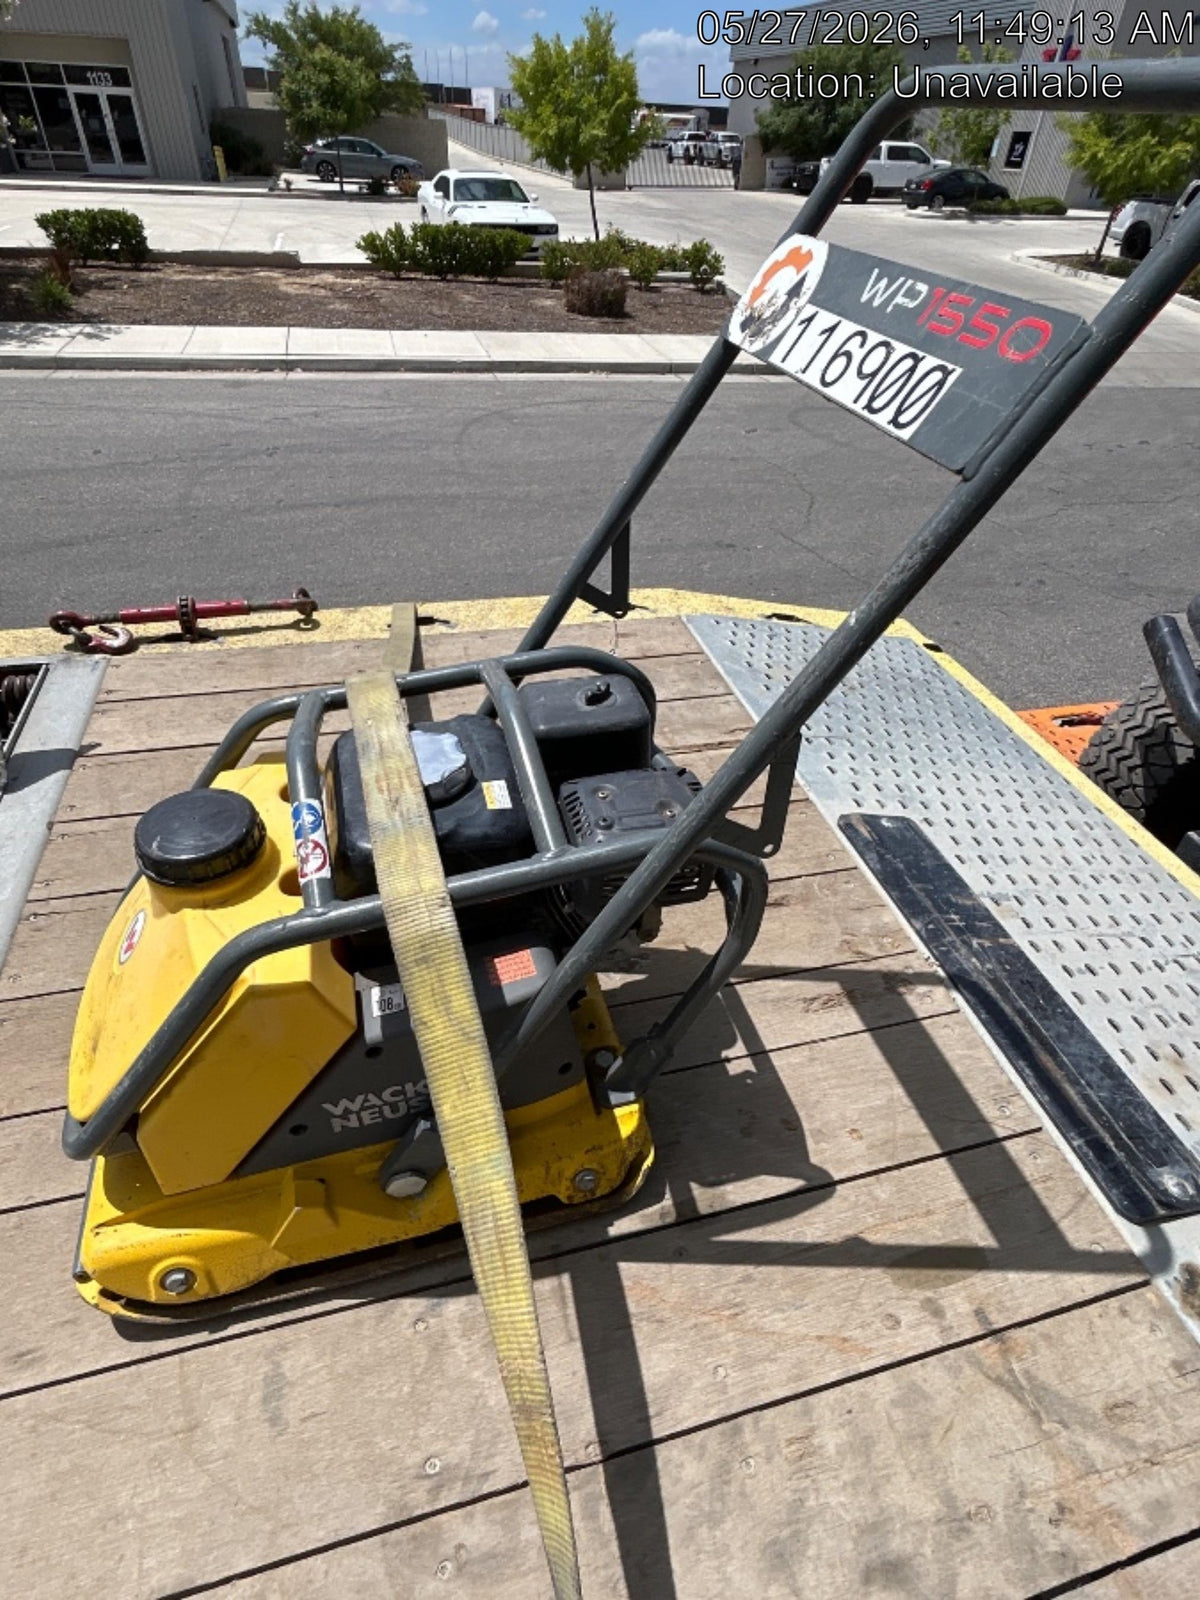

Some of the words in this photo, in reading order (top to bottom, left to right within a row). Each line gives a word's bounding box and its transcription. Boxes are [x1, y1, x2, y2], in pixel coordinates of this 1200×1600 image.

[86, 70, 113, 87] 1133
[860, 267, 1052, 363] WP1550
[780, 311, 957, 430] 116900
[321, 1079, 430, 1116] WACK
[330, 1098, 431, 1133] NEUS
